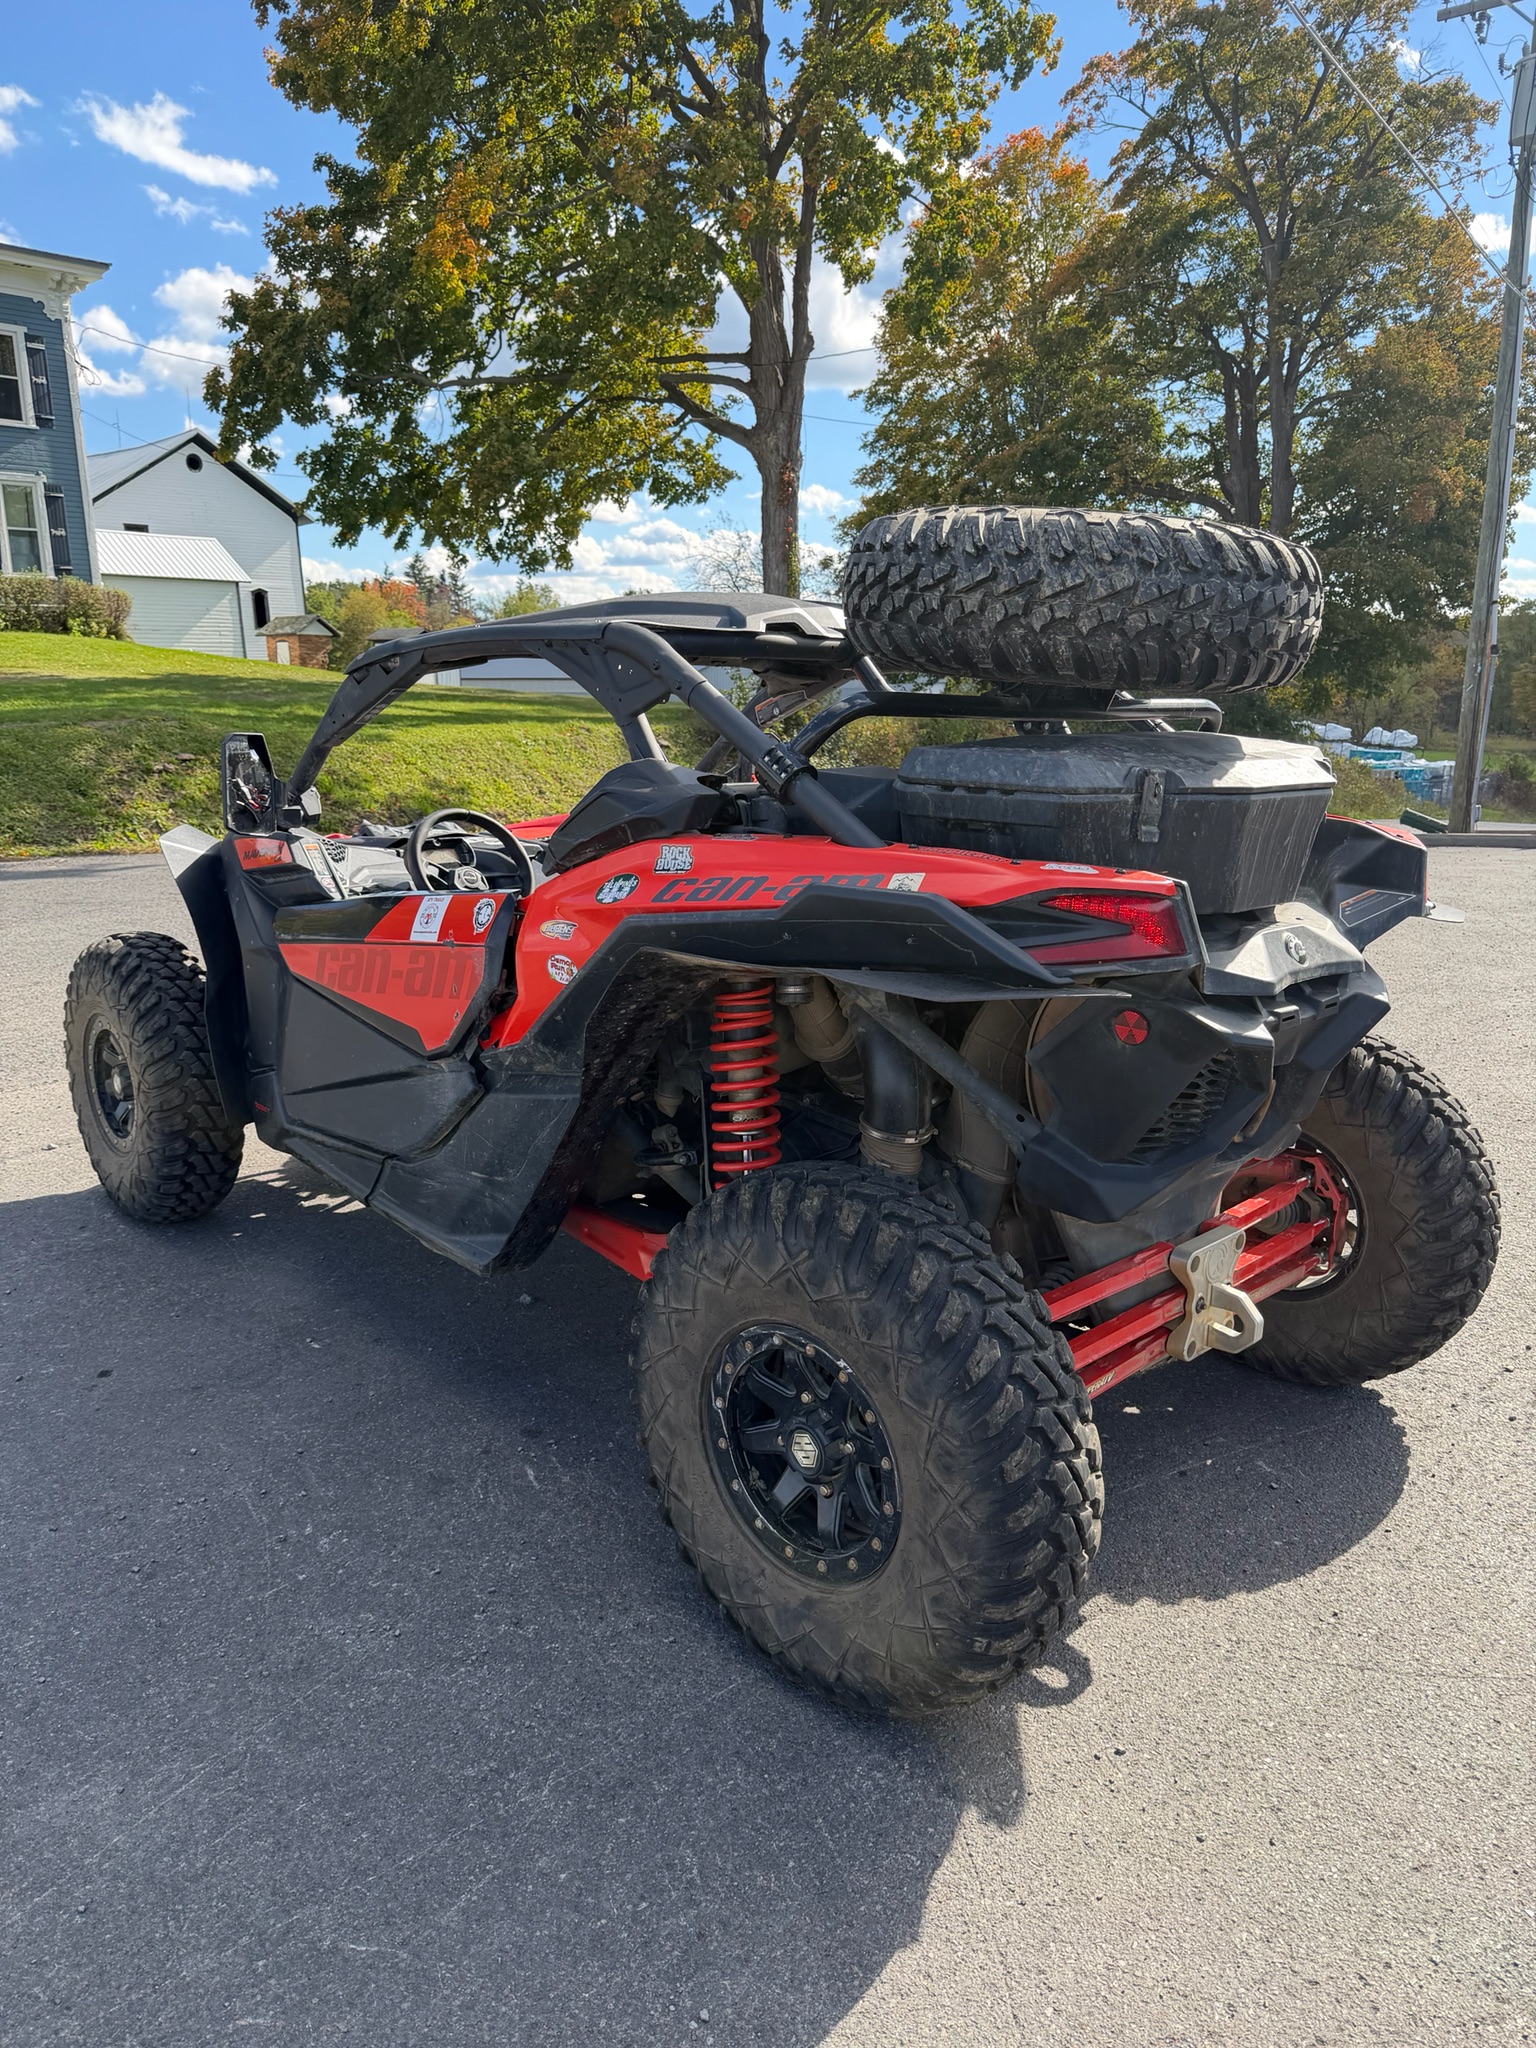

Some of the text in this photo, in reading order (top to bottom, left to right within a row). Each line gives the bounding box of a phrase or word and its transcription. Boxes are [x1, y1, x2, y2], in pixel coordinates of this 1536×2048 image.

[662, 845, 690, 859] ROCK
[656, 858, 692, 871] HOUSE
[651, 874, 885, 902] can-am
[550, 955, 576, 968] Demon
[551, 962, 566, 973] Run
[316, 947, 480, 1000] can-am
